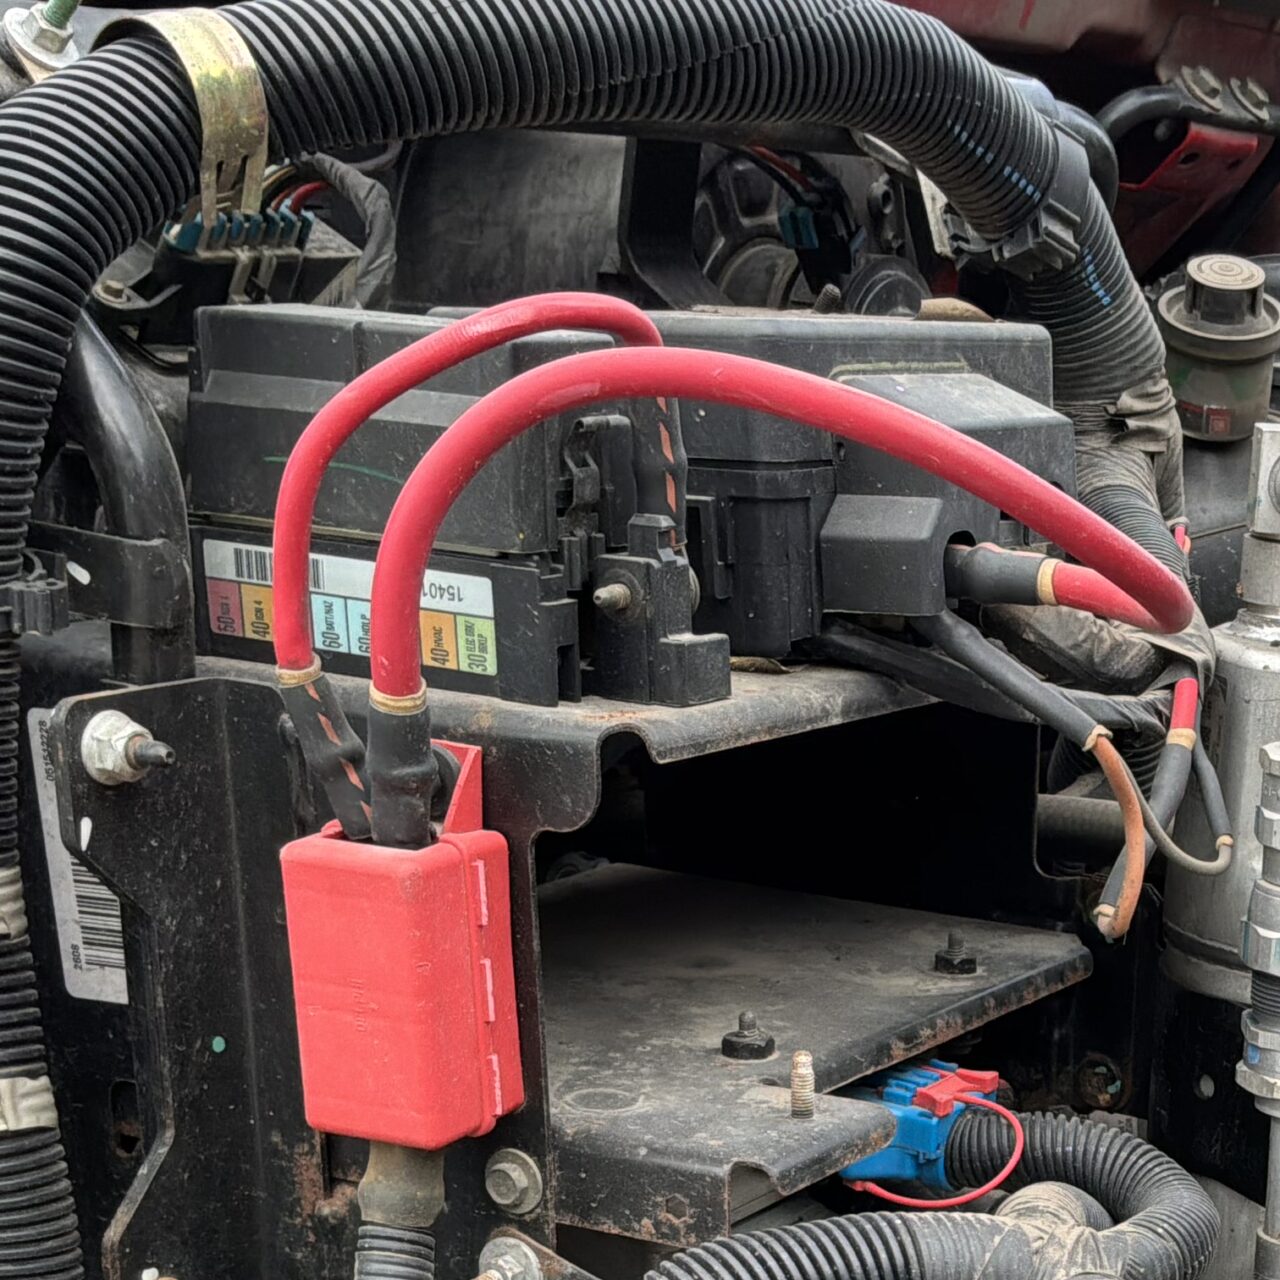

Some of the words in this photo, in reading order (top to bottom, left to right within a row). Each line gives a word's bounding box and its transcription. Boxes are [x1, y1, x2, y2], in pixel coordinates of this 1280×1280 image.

[251, 620, 270, 638] 40
[433, 626, 444, 648] HVAC
[321, 631, 342, 649] 60
[430, 648, 450, 665] 40
[467, 654, 488, 672] 30
